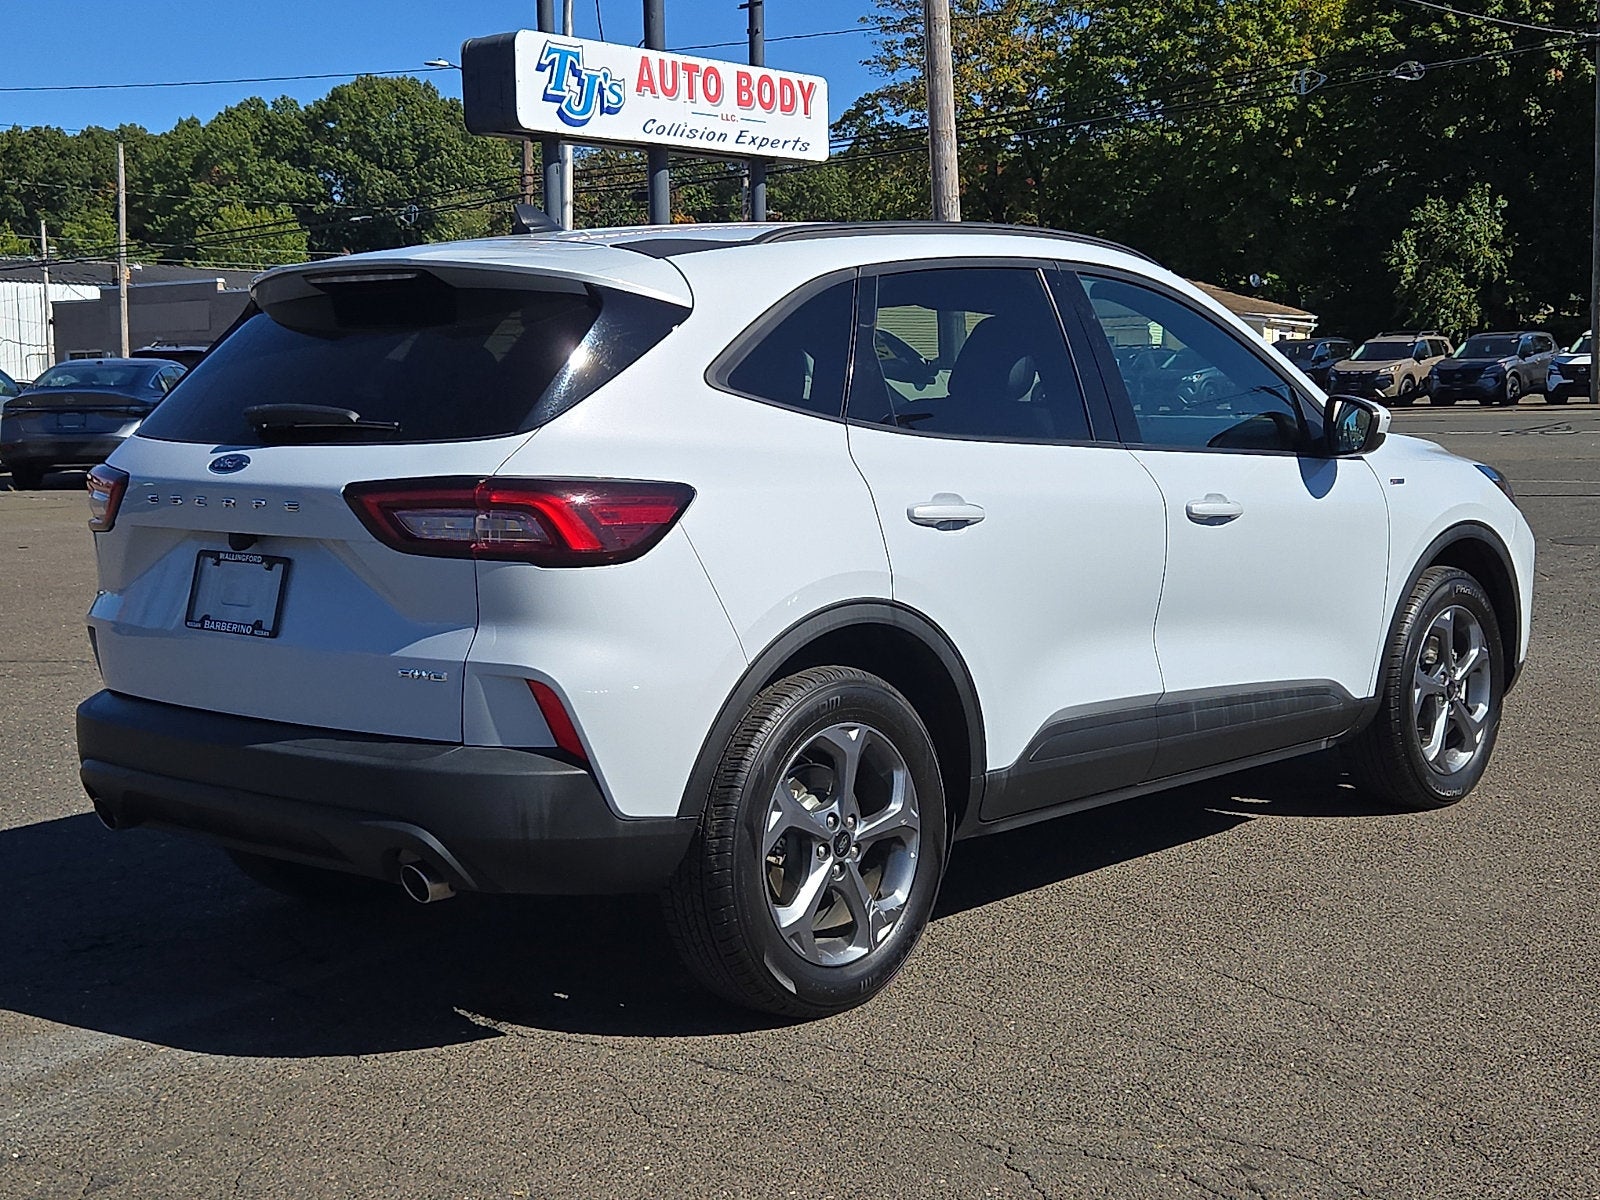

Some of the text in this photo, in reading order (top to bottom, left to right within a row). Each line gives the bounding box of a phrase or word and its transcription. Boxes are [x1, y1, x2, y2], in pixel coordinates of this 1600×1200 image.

[536, 40, 817, 127] TJ's AUTO BODY
[720, 112, 739, 123] LLC.
[642, 118, 811, 152] Collision Experts
[219, 552, 262, 563] WALLINGFORD
[203, 620, 253, 635] BARBERINO
